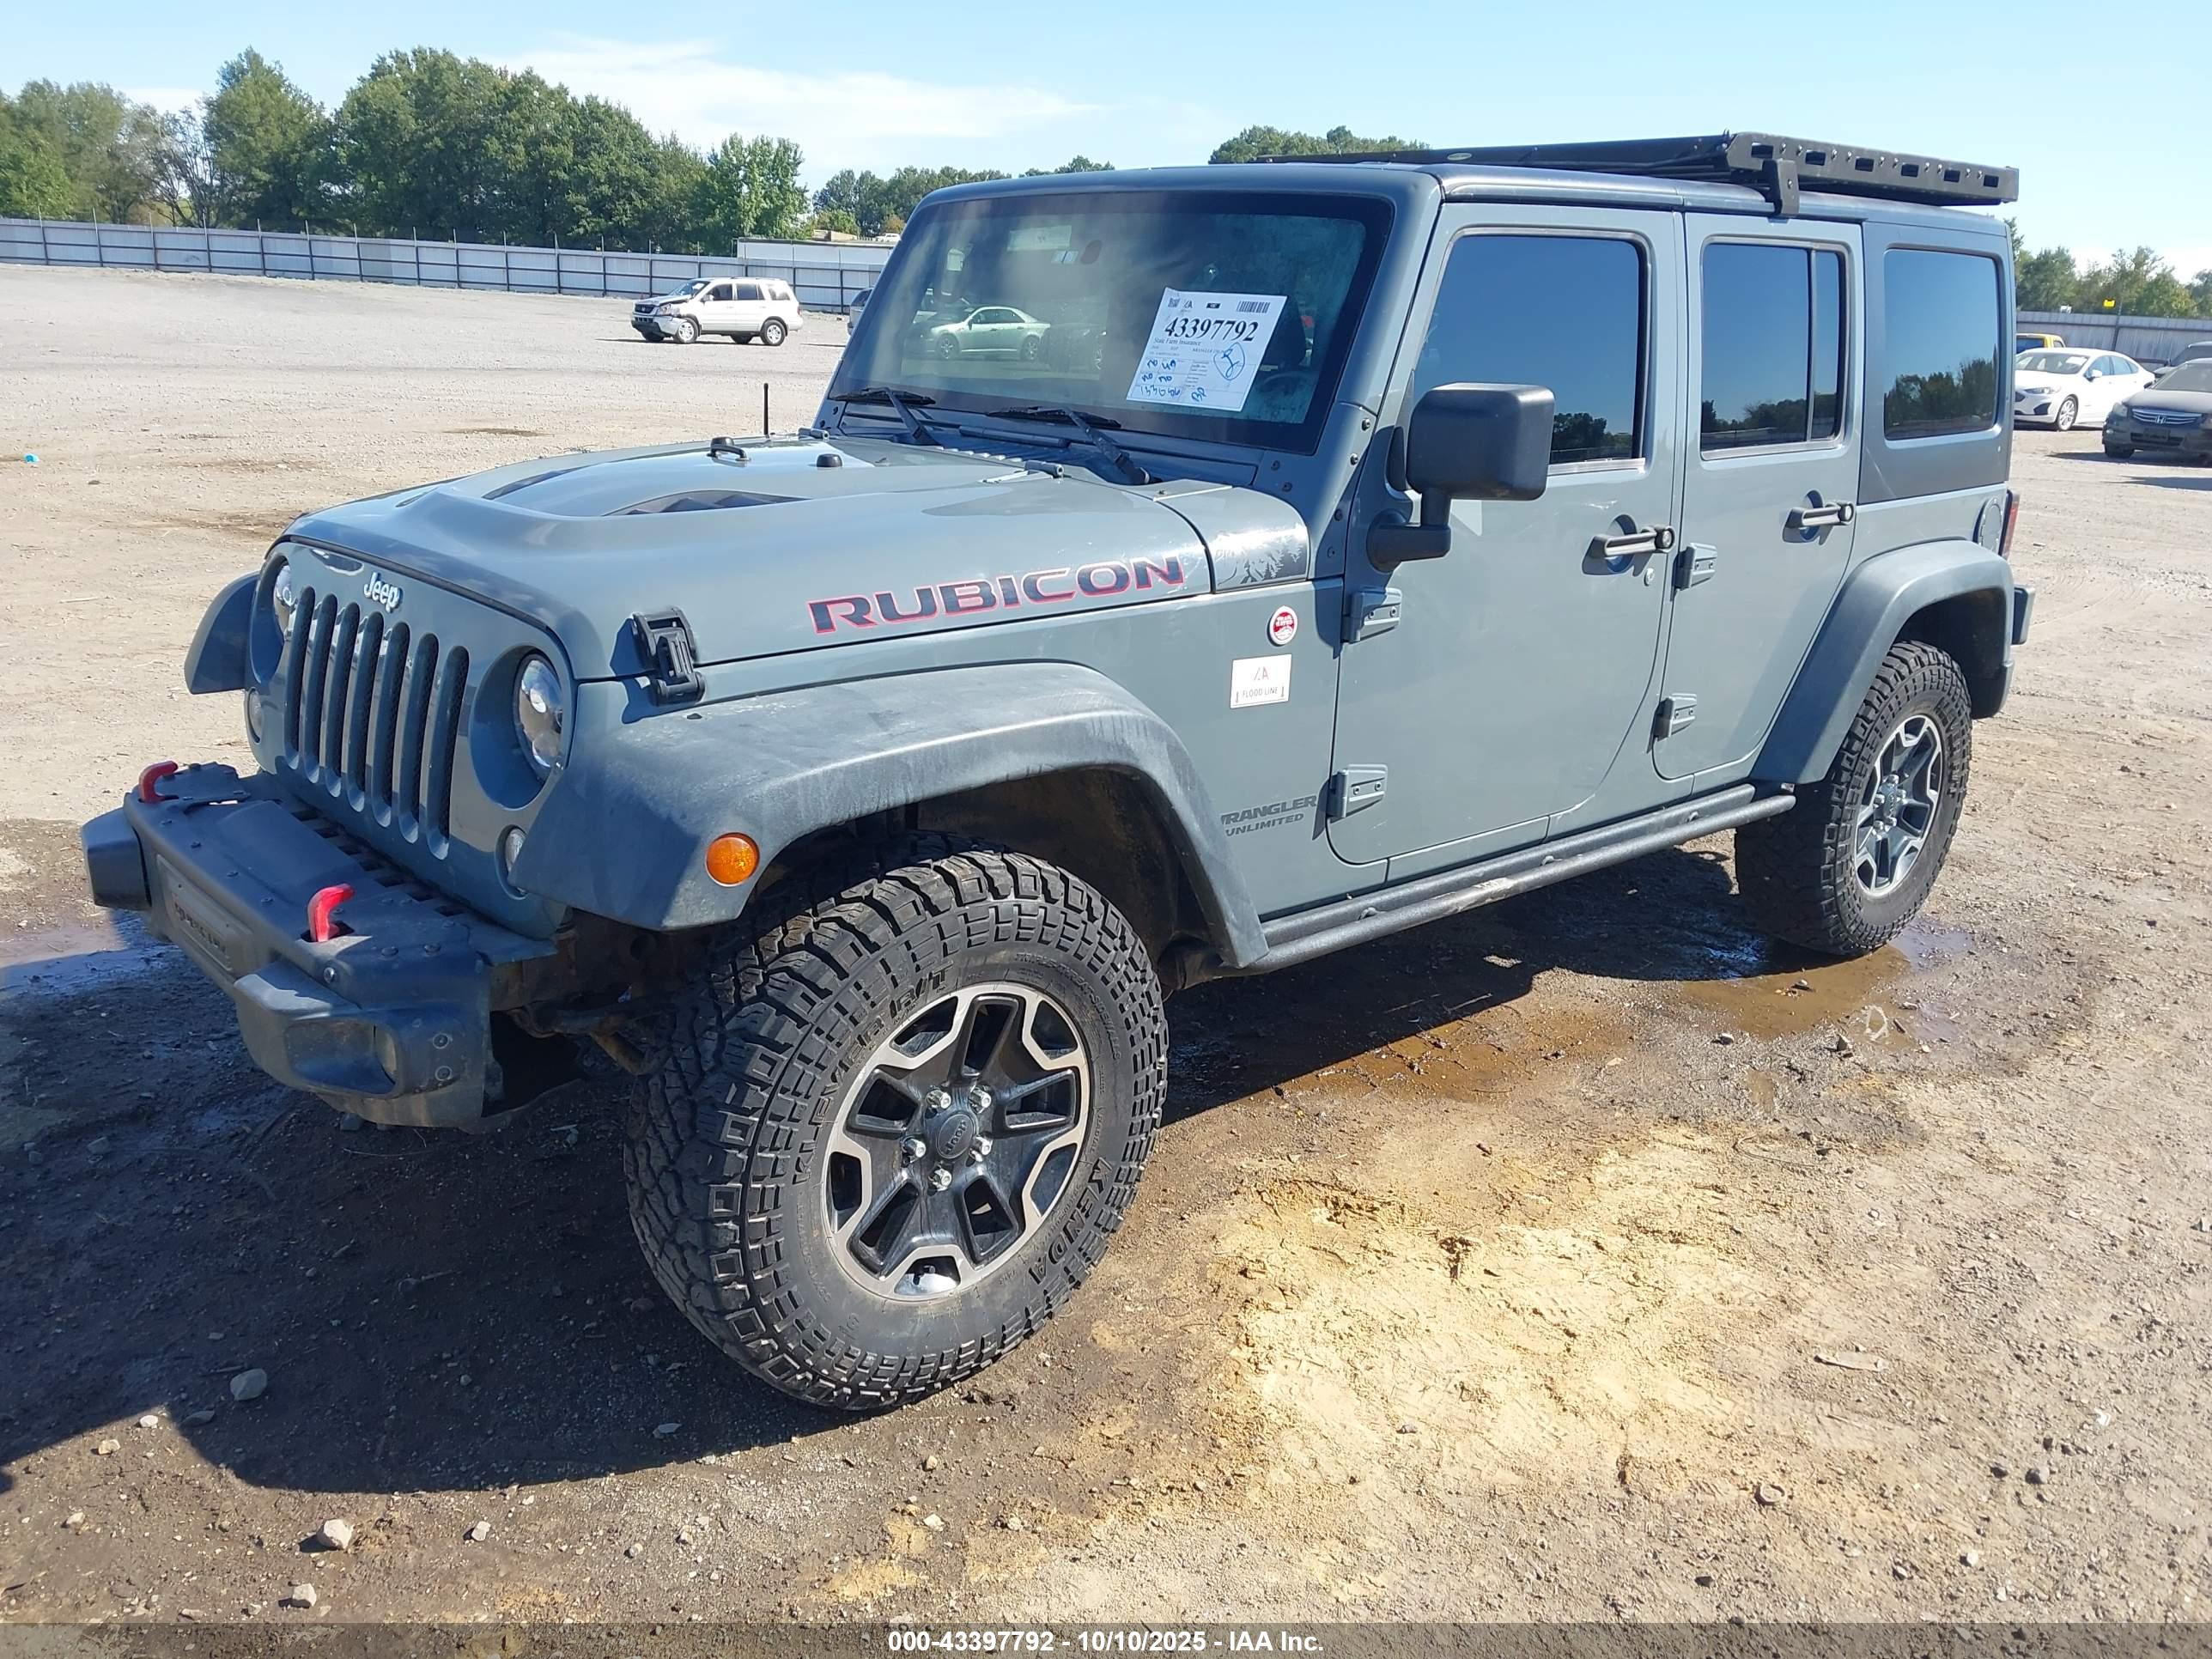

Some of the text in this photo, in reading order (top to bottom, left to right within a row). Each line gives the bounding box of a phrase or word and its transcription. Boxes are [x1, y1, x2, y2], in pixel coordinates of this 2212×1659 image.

[1164, 317, 1259, 342] 43397792
[364, 572, 400, 613] Jeep
[807, 556, 1184, 633] RUBICON
[1242, 686, 1278, 698] FLOOD LINE
[1225, 813, 1304, 836] UNLIMITED
[1028, 1157, 1114, 1285] KENDA
